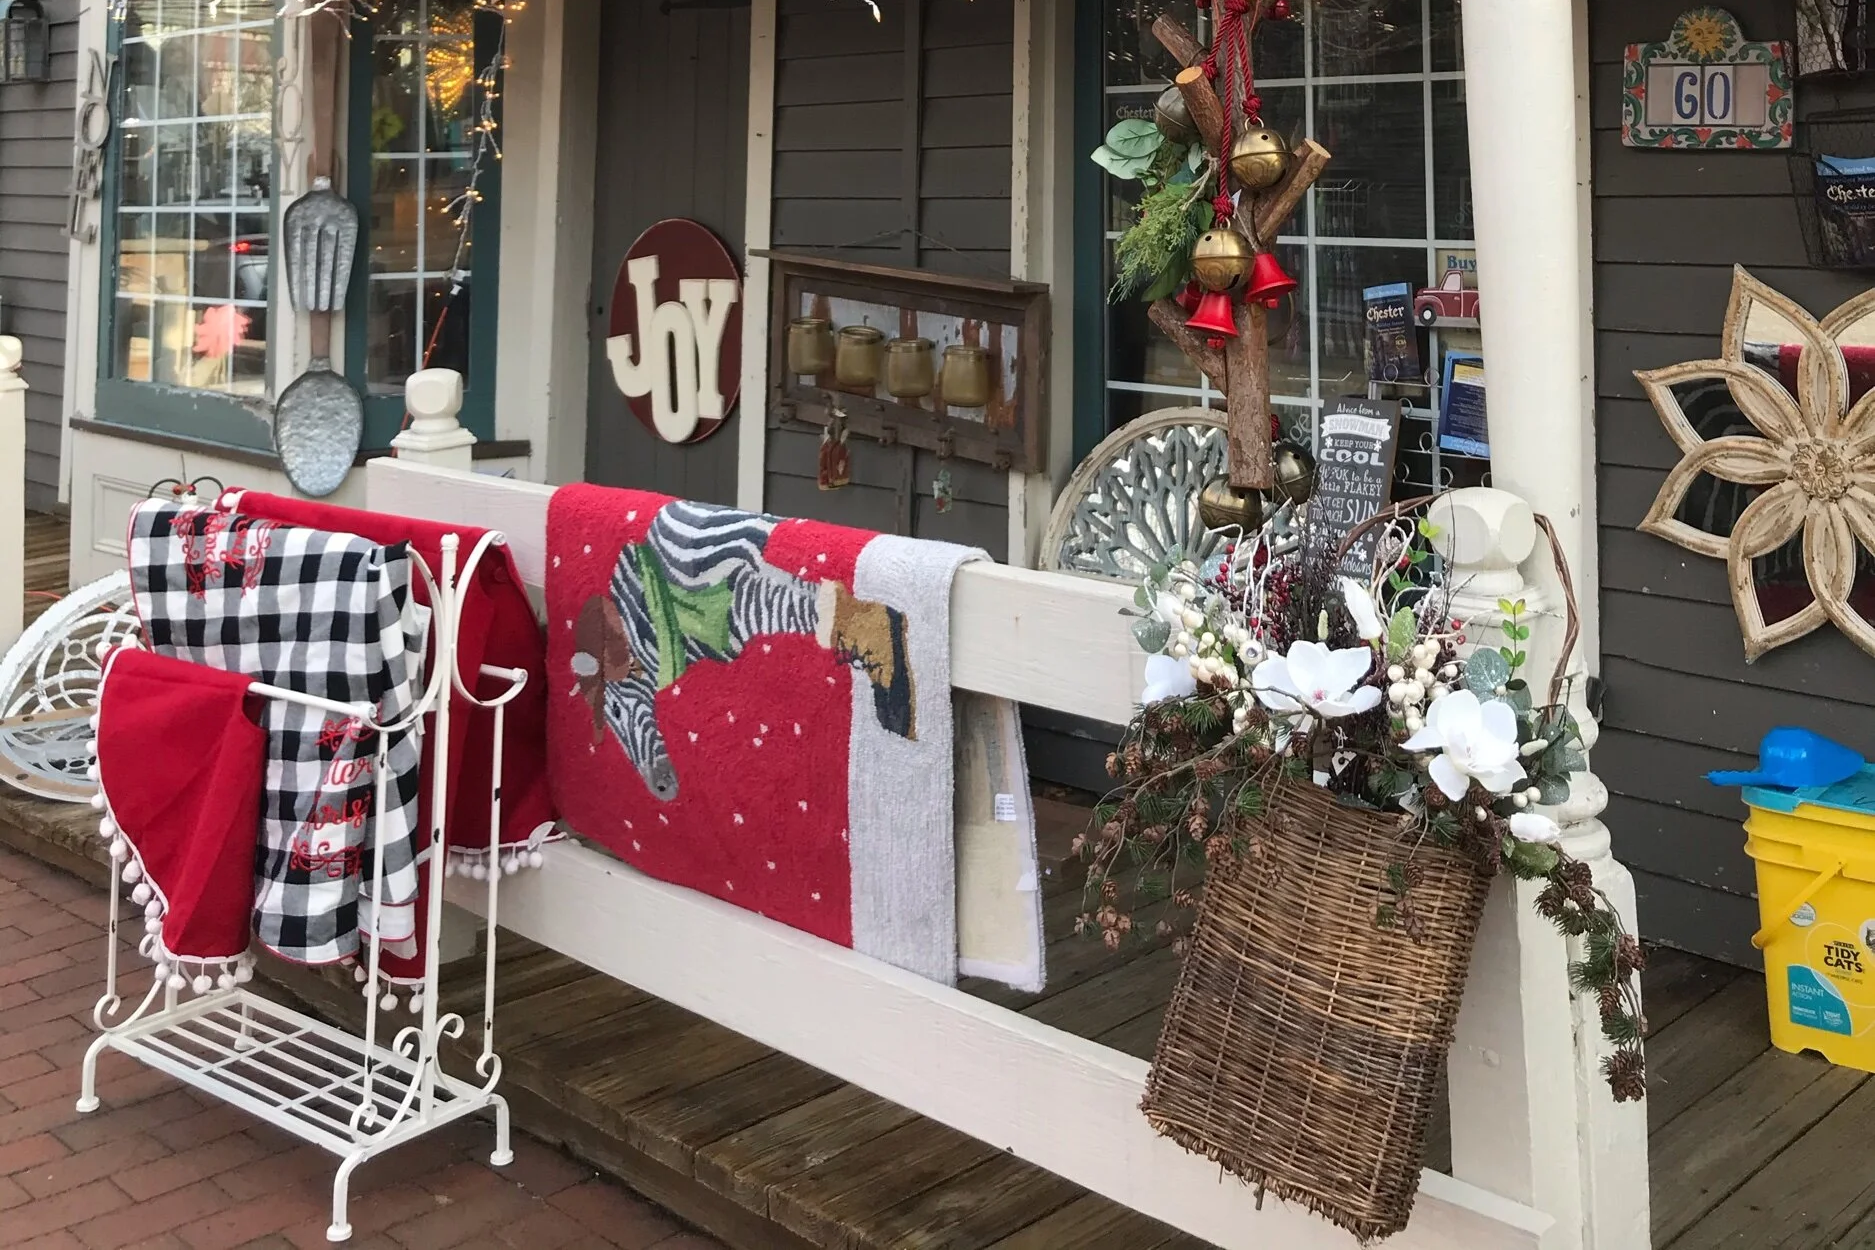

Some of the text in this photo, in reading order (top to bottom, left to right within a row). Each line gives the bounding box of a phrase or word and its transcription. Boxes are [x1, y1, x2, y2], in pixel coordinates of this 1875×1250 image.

[276, 13, 304, 196] JOY
[1674, 70, 1731, 121] 60
[60, 47, 119, 244] NOEL
[1366, 304, 1405, 323] Chester
[606, 254, 739, 444] JOY
[1328, 417, 1386, 436] SNOWMAN
[1334, 438, 1375, 449] KEEP YOUR
[1320, 448, 1385, 467] COOL
[1351, 470, 1361, 482] to
[1363, 469, 1374, 483] be
[1343, 480, 1383, 497] FLAKEY
[1343, 498, 1380, 525] SUN
[1823, 944, 1861, 962] TIDY
[1823, 955, 1864, 974] CATS
[1791, 982, 1825, 998] INSTANT
